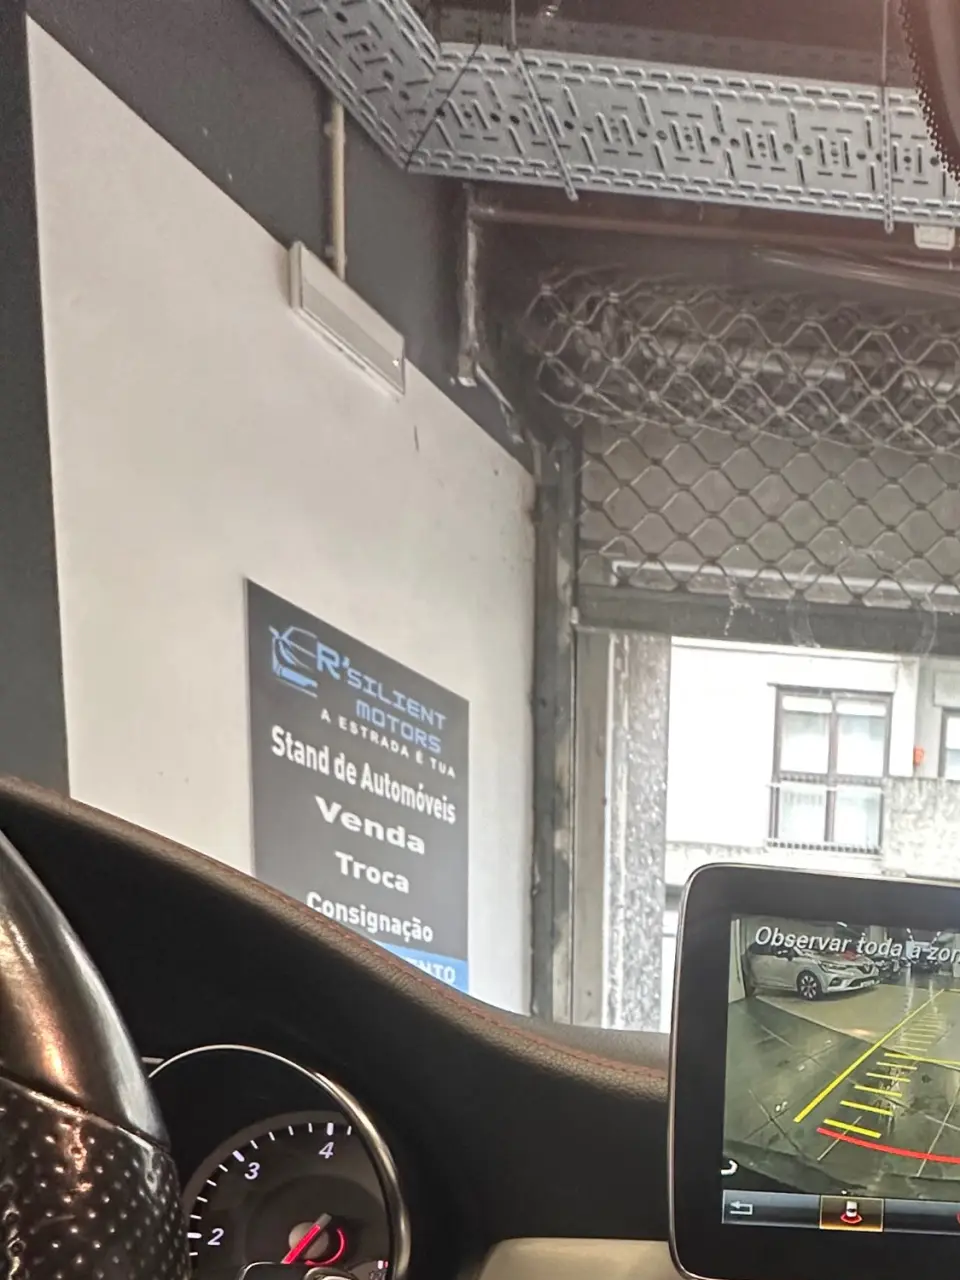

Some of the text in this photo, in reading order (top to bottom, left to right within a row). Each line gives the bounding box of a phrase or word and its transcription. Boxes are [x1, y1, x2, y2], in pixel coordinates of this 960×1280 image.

[320, 708, 331, 723] A
[339, 716, 410, 759] ESTRADA
[430, 757, 456, 779] TUA
[356, 699, 442, 755] MOTORS
[271, 725, 456, 825] Stand de Automóveis
[315, 795, 425, 855] Venda
[335, 851, 410, 894] Troca
[306, 891, 434, 943] Consignação
[755, 926, 852, 954] Observar
[857, 938, 903, 957] toda
[908, 945, 921, 960] a
[244, 1162, 261, 1180] 3
[319, 1141, 335, 1159] 4
[207, 1228, 224, 1246] 2
